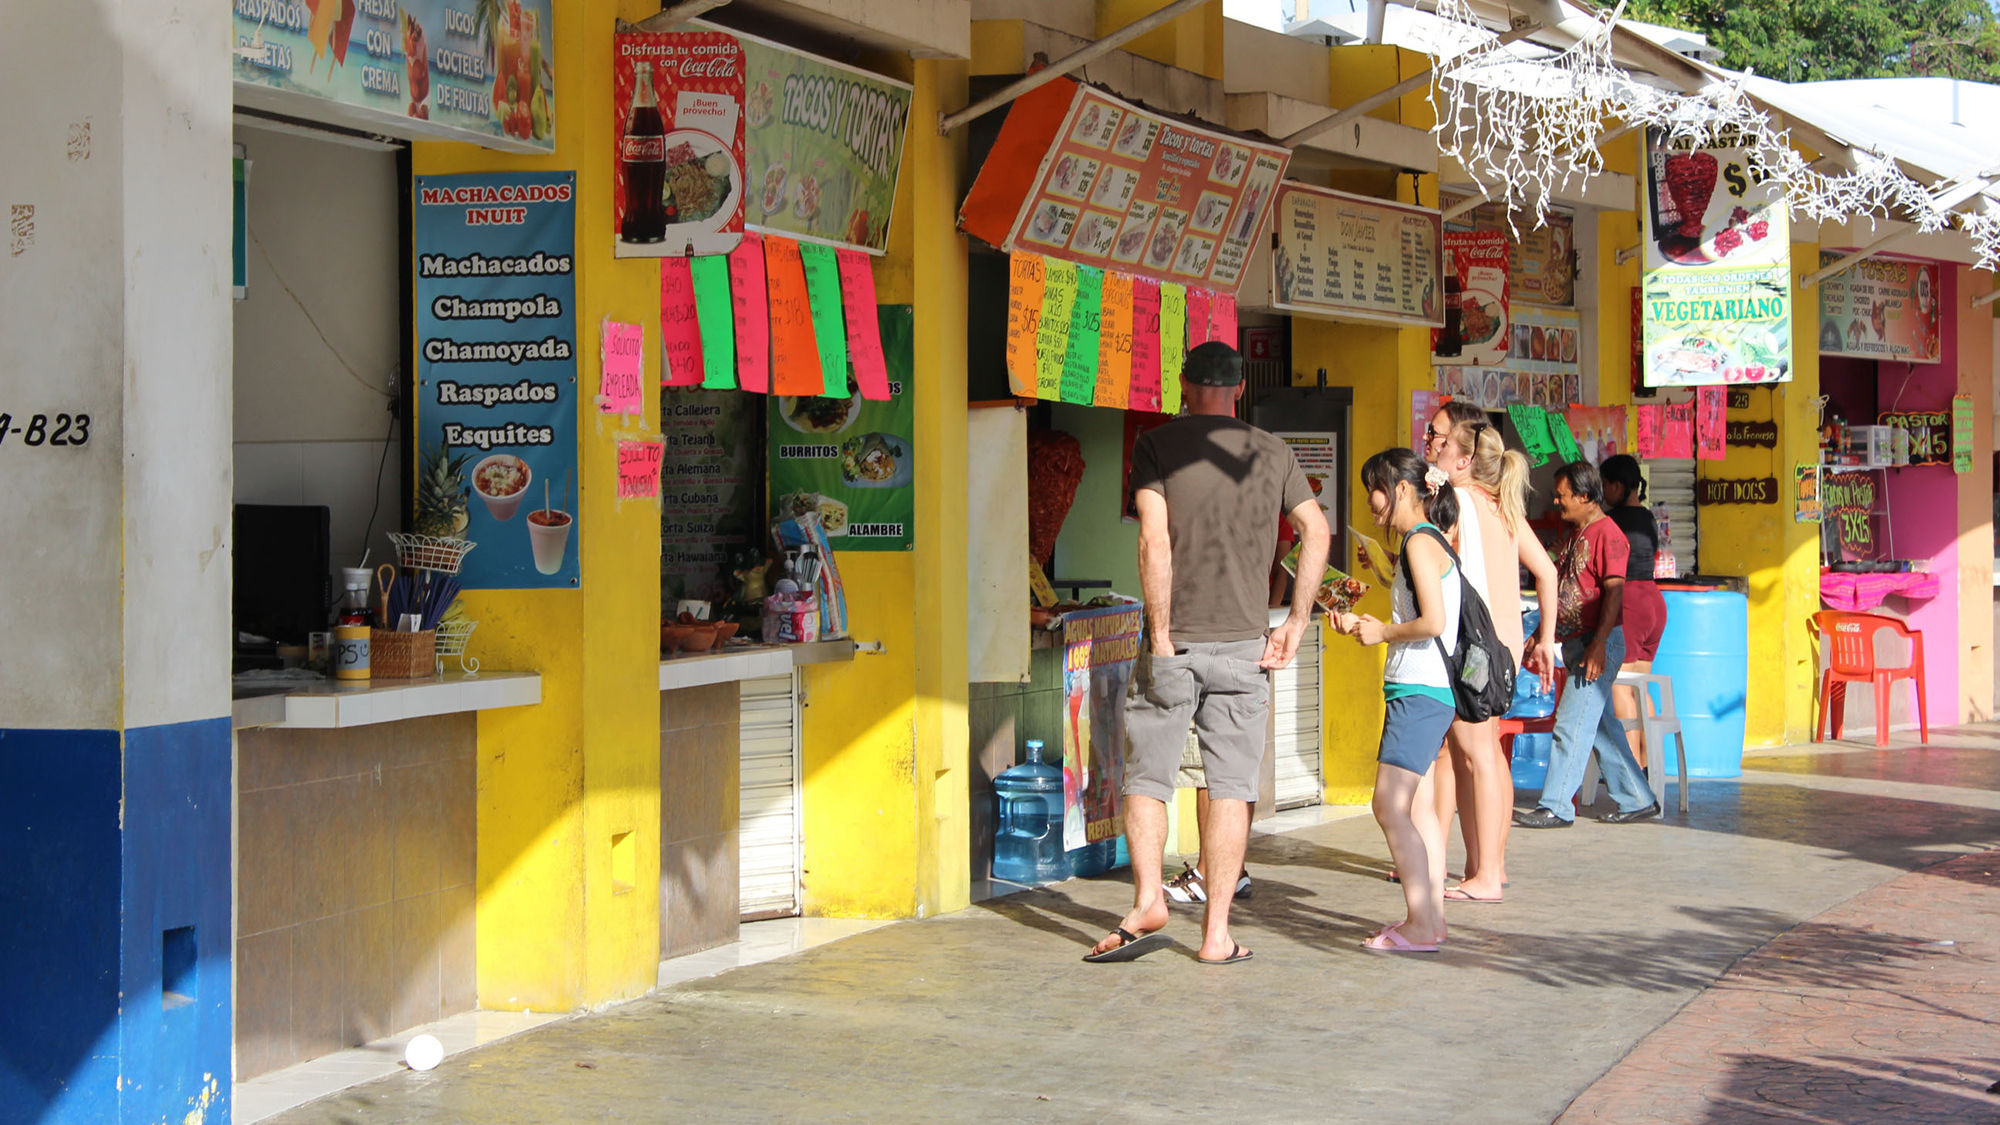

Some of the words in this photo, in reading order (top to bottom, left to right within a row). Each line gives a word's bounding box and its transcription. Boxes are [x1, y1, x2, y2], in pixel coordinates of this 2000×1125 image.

[239, 0, 302, 31] RASPADOS
[444, 7, 475, 36] JUGOS
[366, 28, 393, 56] CON
[621, 43, 674, 57] Disfruta
[677, 46, 688, 56] tu
[691, 43, 739, 56] comida
[436, 47, 485, 80] COCTELES
[659, 59, 678, 68] con
[361, 64, 400, 96] CREMA
[437, 83, 451, 107] DE
[453, 88, 490, 119] FRUTAS
[682, 106, 727, 116] provecho!
[692, 98, 719, 108] ¡Buen
[782, 73, 836, 136] TACOS
[830, 79, 850, 140] Y
[843, 81, 903, 182] TORTAS
[1159, 126, 1184, 151] Tacos
[1188, 136, 1216, 160] tortas
[420, 184, 572, 205] MACHACADOS
[465, 207, 528, 226] INUIT
[420, 251, 573, 279] Machacados
[1013, 259, 1042, 283] TORTAS
[1662, 274, 1698, 284] TODAS
[1700, 273, 1721, 283] LAS
[1723, 271, 1774, 282] ORDENES
[1685, 285, 1736, 295] TAMBIEN
[1736, 284, 1751, 293] EN
[432, 294, 562, 321] Champola
[1652, 297, 1783, 321] VEGETARIANO
[1021, 308, 1039, 335] $15
[424, 338, 571, 364] Chamoyada
[610, 338, 642, 358] SOLICITO
[439, 381, 557, 408] Raspados
[605, 372, 641, 400] EMPLEADA
[675, 403, 721, 417] Callejera
[1886, 414, 1949, 428] PASTOR
[445, 424, 553, 450] Esquites
[779, 445, 839, 458] BURRITOS
[677, 462, 721, 475] Alemana
[681, 492, 719, 504] Cubana
[1707, 483, 1729, 500] HOT
[1733, 482, 1767, 501] DOGS
[687, 521, 714, 533] Suiza
[849, 525, 904, 538] ALAMBRE
[1841, 512, 1870, 543] 3X15
[1064, 617, 1092, 646] AGUAS
[1067, 643, 1092, 673] 100%
